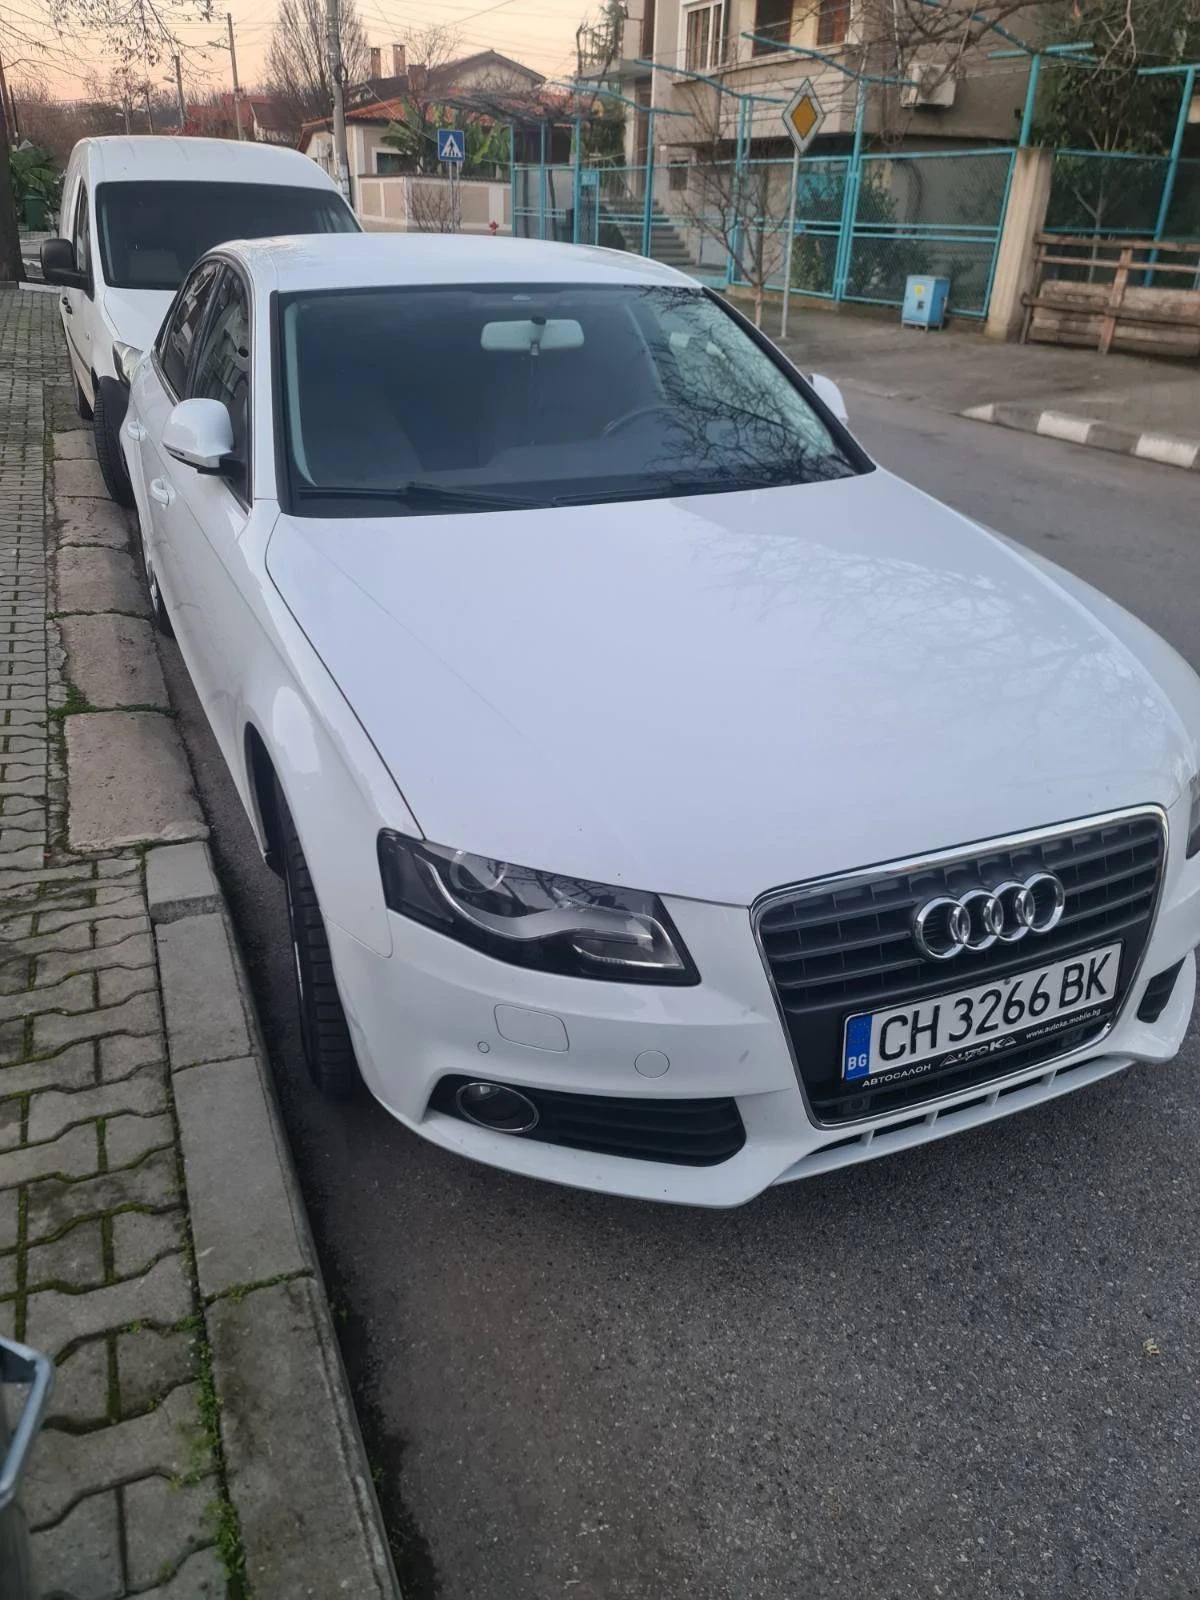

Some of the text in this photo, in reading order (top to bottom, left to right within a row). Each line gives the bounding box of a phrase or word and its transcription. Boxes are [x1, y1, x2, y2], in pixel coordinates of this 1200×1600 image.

[879, 952, 1112, 1062] CH 3266 BK
[847, 1054, 868, 1071] BG
[862, 1063, 931, 1088] АВТОСАЛОН
